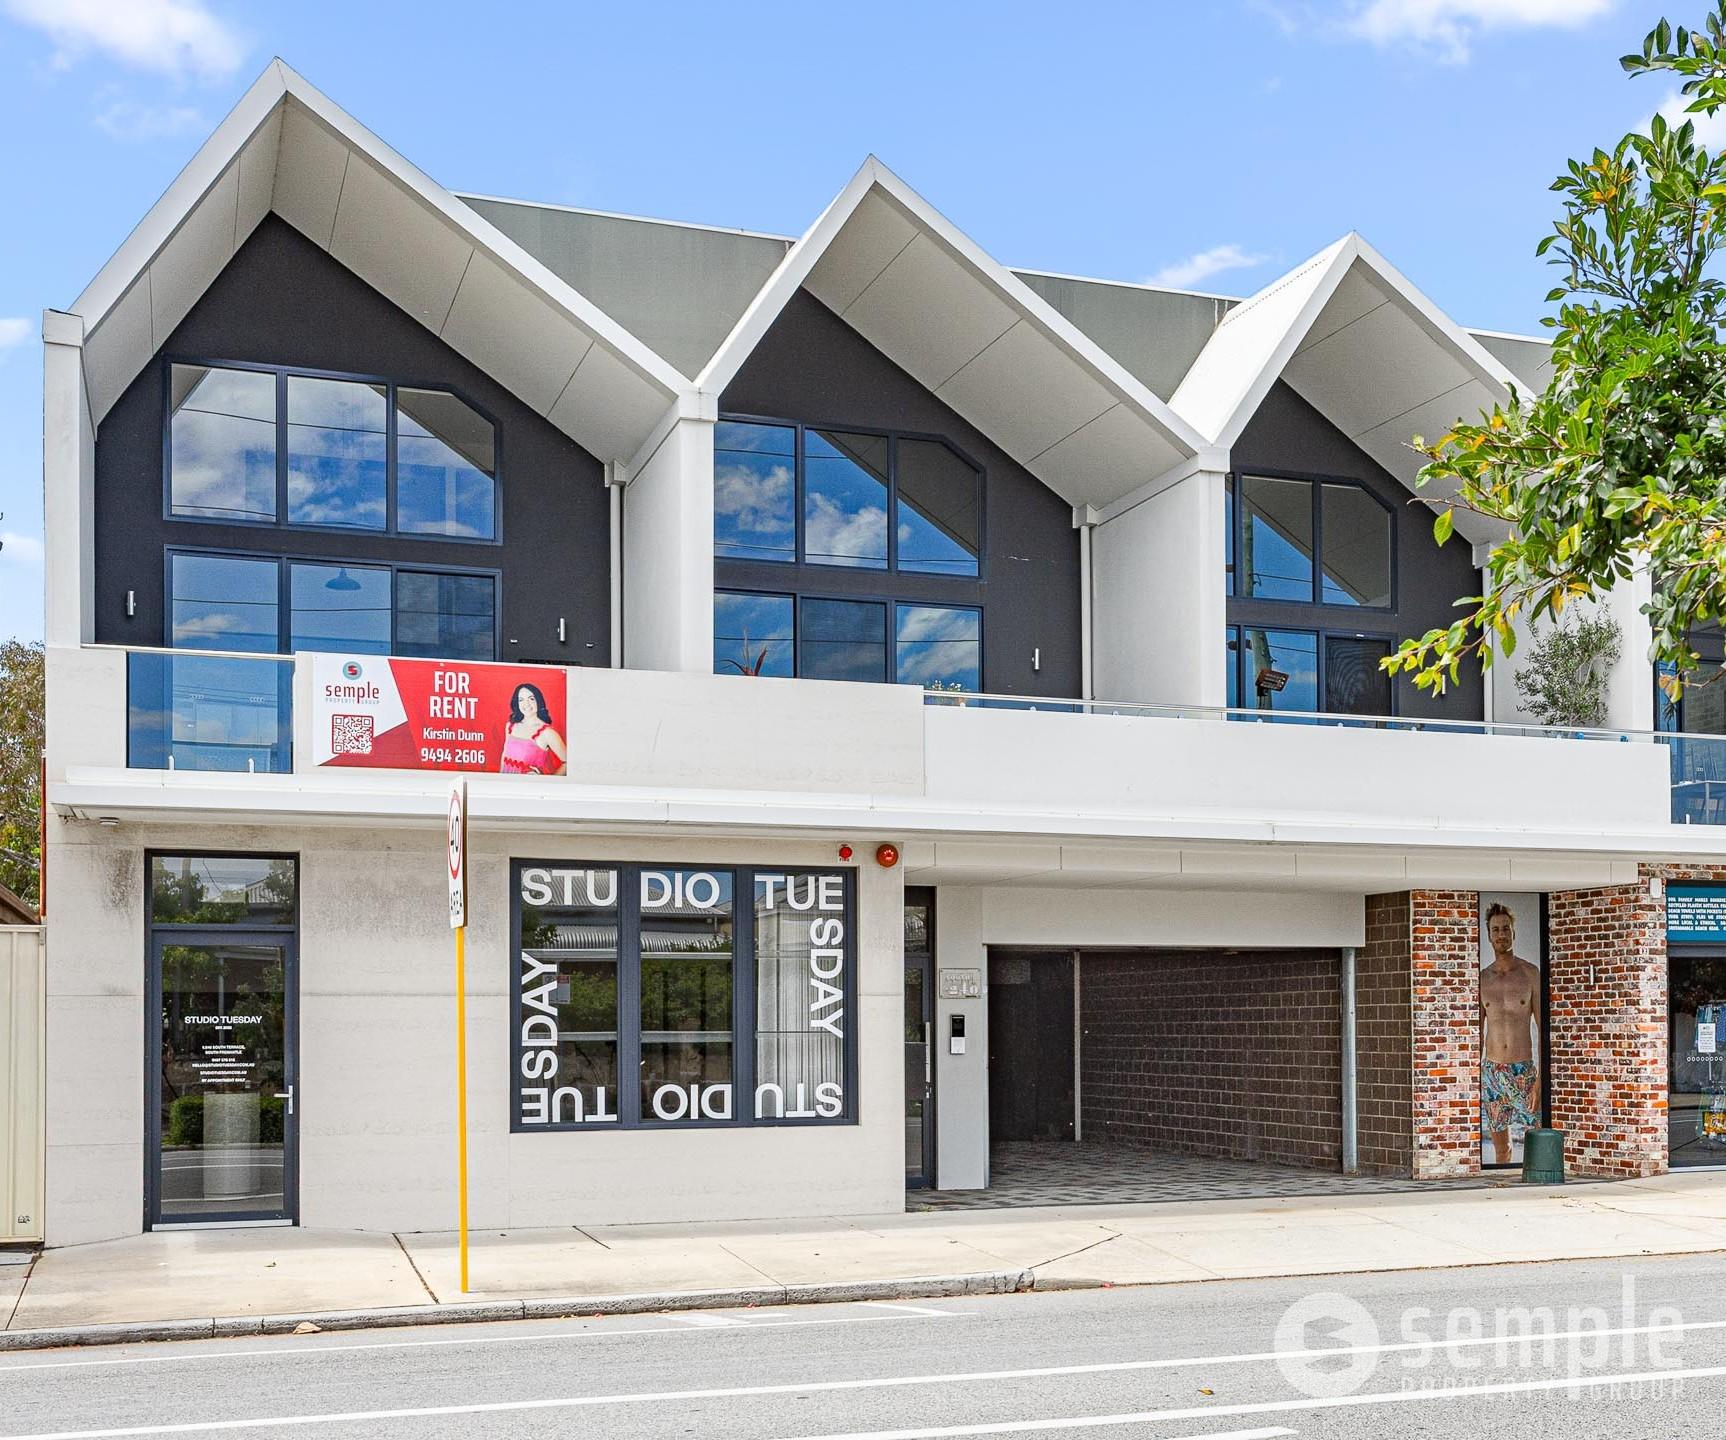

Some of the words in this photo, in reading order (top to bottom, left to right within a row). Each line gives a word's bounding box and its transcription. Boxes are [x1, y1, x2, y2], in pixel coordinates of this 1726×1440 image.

[325, 681, 380, 704] semple
[434, 671, 470, 695] FOR
[429, 696, 479, 720] RENT
[423, 727, 455, 741] Kirstin
[458, 728, 484, 742] Dunn
[421, 747, 452, 763] 9494
[455, 748, 485, 765] 2606
[184, 1015, 220, 1024] STUDIO
[220, 1015, 263, 1024] TUESDAY
